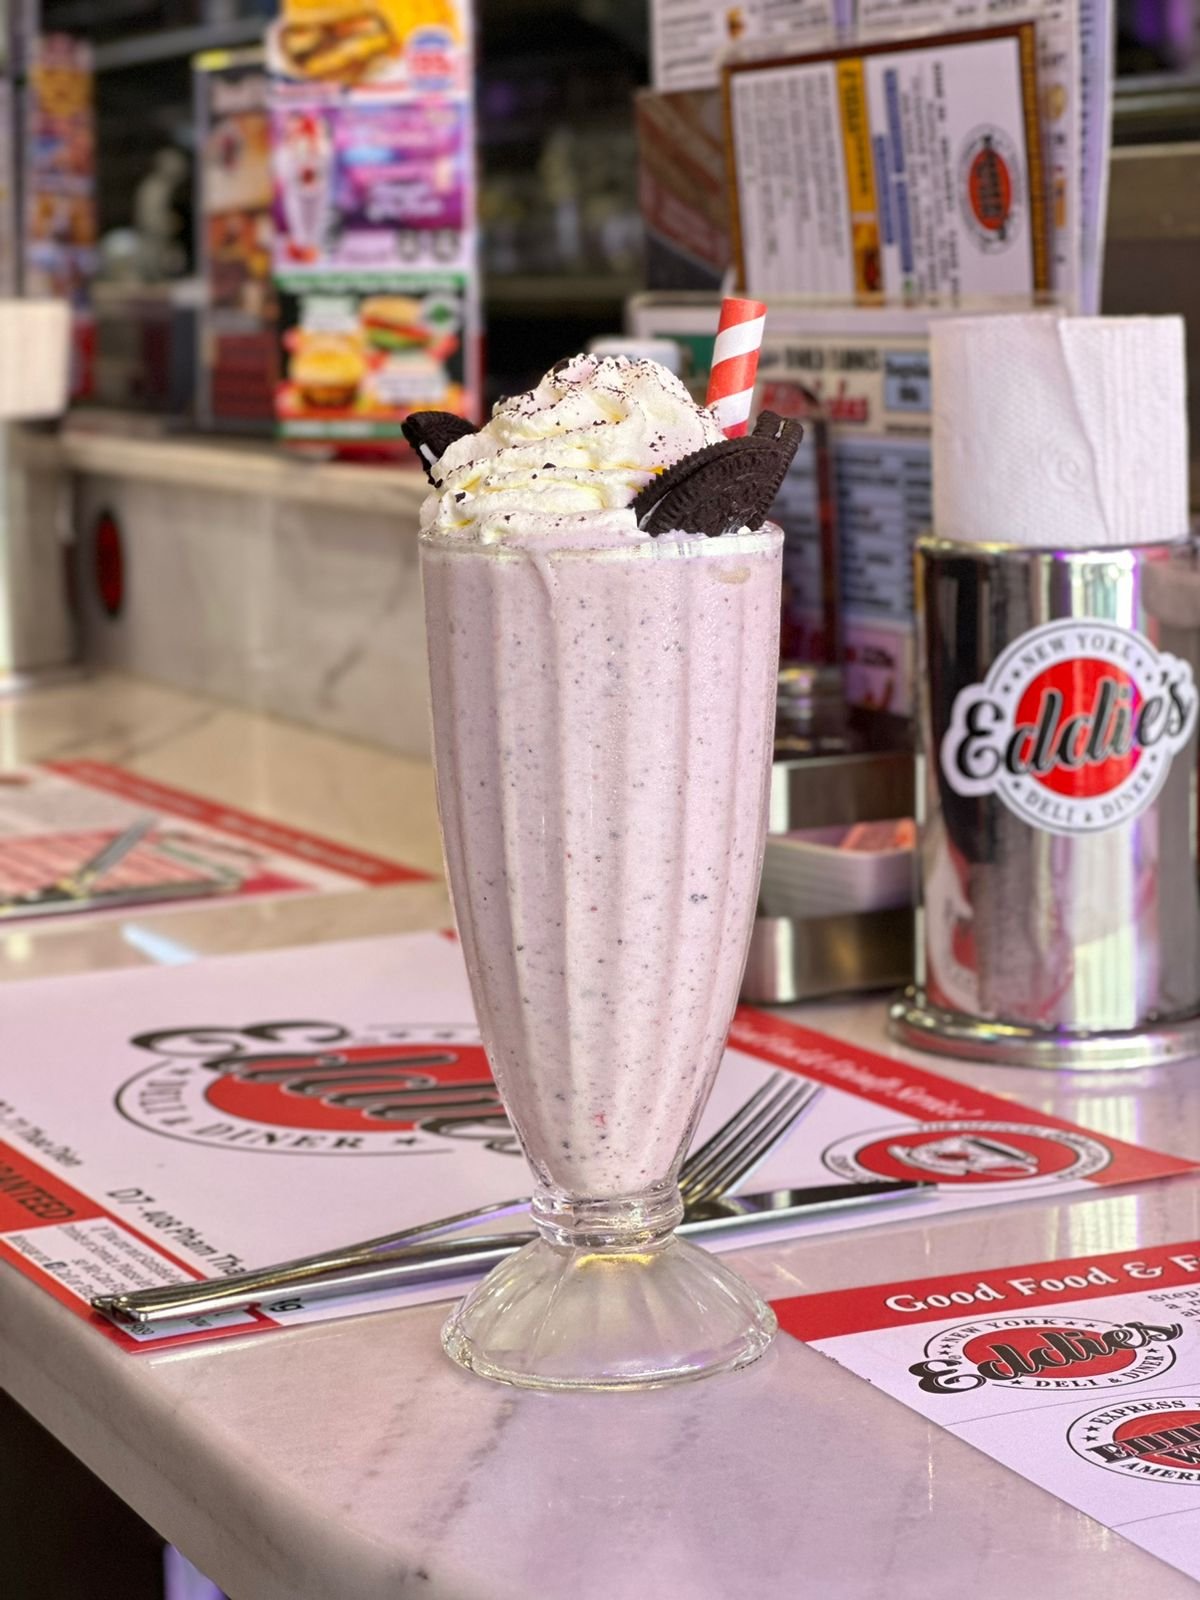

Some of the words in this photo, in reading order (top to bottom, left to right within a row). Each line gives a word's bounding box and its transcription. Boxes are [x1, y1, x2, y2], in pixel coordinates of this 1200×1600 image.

[1020, 634, 1066, 670] NEW
[1076, 634, 1133, 660] YORK
[956, 671, 1188, 780] Eddie's
[1025, 790, 1074, 823] DELI
[1101, 767, 1153, 820] DINER
[190, 1122, 366, 1150] DINER
[885, 1282, 1006, 1313] Good
[1008, 1266, 1119, 1296] Food
[1122, 1261, 1163, 1279] &
[940, 1325, 982, 1344] NEW
[984, 1318, 1056, 1329] YORK
[908, 1321, 1184, 1394] Eddie's
[1035, 1379, 1100, 1388] DELI
[1120, 1354, 1165, 1380] DINER
[1088, 1399, 1187, 1426] EXPRESS
